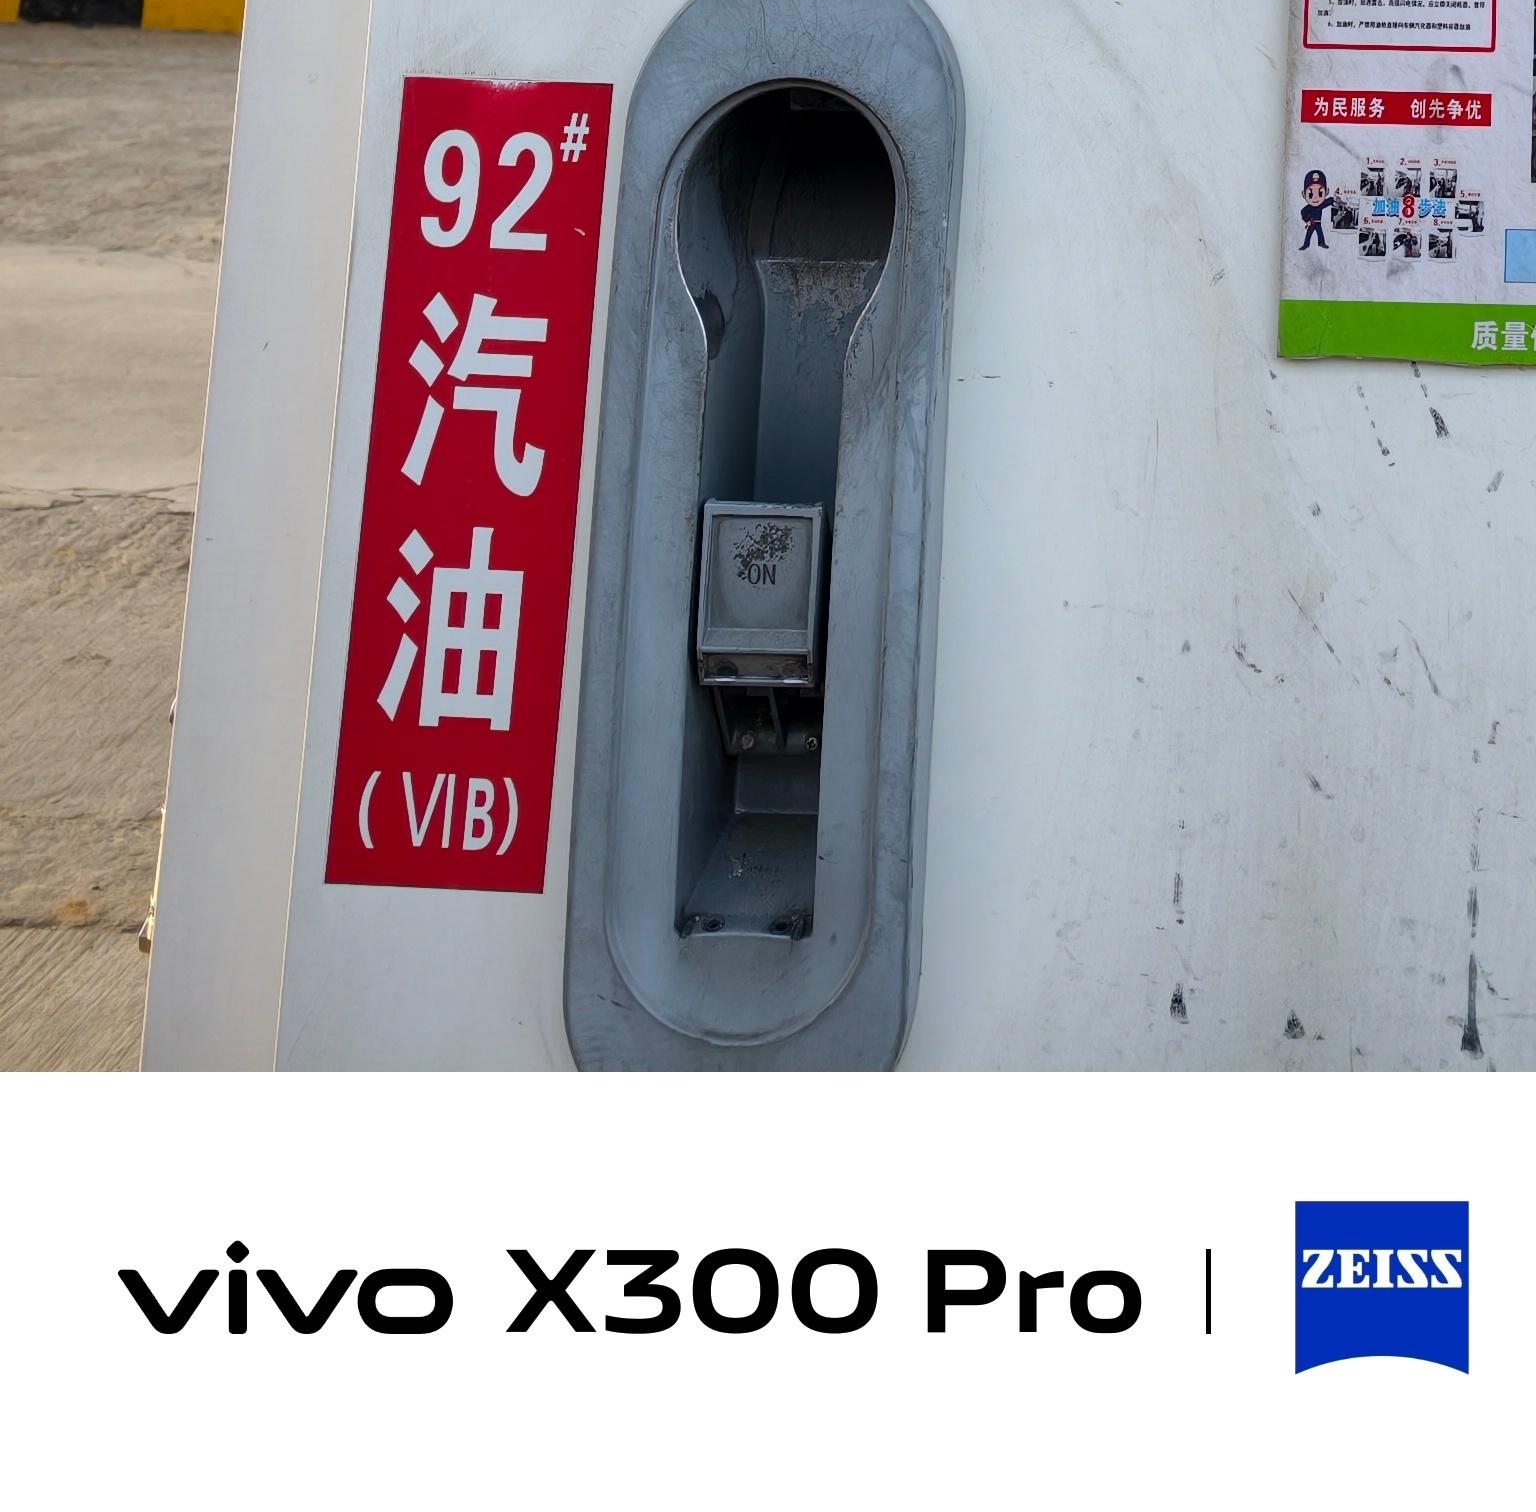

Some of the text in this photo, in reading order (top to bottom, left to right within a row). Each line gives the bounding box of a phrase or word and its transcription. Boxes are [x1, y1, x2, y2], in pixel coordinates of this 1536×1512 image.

[1313, 96, 1482, 120] 为民服务 创先争优
[420, 112, 590, 253] 92#
[1372, 193, 1447, 219] 加油8步法
[376, 291, 549, 733] 汽油
[747, 563, 777, 585] ON
